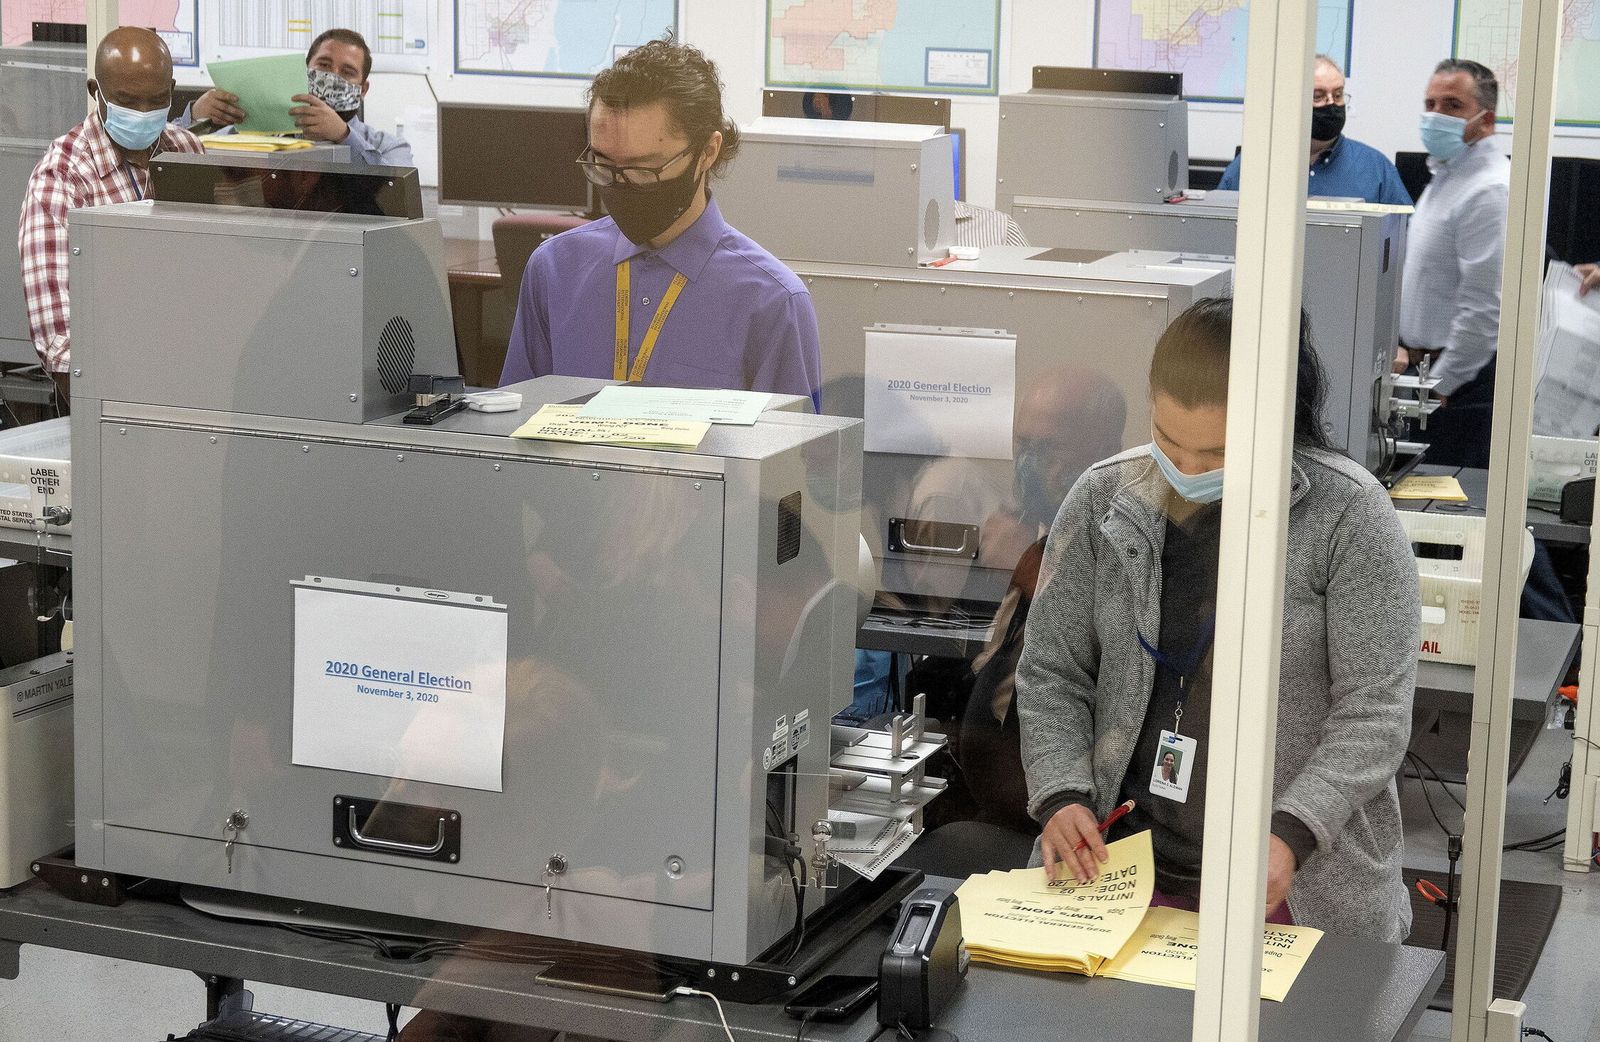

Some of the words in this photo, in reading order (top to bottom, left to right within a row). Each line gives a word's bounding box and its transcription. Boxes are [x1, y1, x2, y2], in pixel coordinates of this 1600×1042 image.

[887, 379, 911, 389] 2020
[913, 381, 951, 392] General
[953, 383, 992, 394] Election
[910, 394, 943, 402] November
[952, 396, 969, 404] 2020
[30, 468, 59, 478] LABEL
[30, 477, 60, 486] OTHER
[37, 486, 55, 495] END
[12, 510, 33, 518] STATES
[1419, 640, 1441, 654] AIL
[326, 660, 358, 677] 2020
[361, 664, 414, 684] General
[418, 671, 473, 691] Election
[24, 682, 54, 699] MARTIN
[55, 675, 74, 690] YALE
[357, 684, 403, 699] November
[406, 690, 414, 701] 3,
[416, 692, 439, 703] 2020
[1100, 864, 1137, 882] DATE:
[1094, 879, 1136, 893] NODE:
[1073, 891, 1134, 902] INITIALS:
[1011, 905, 1055, 915] DONE
[983, 912, 1034, 923] ELECTION
[1059, 911, 1104, 921] VBM's
[1263, 935, 1294, 944] NOD
[1167, 941, 1198, 949] ONE
[1263, 941, 1291, 949] INIT
[1141, 950, 1193, 960] ELECTION
